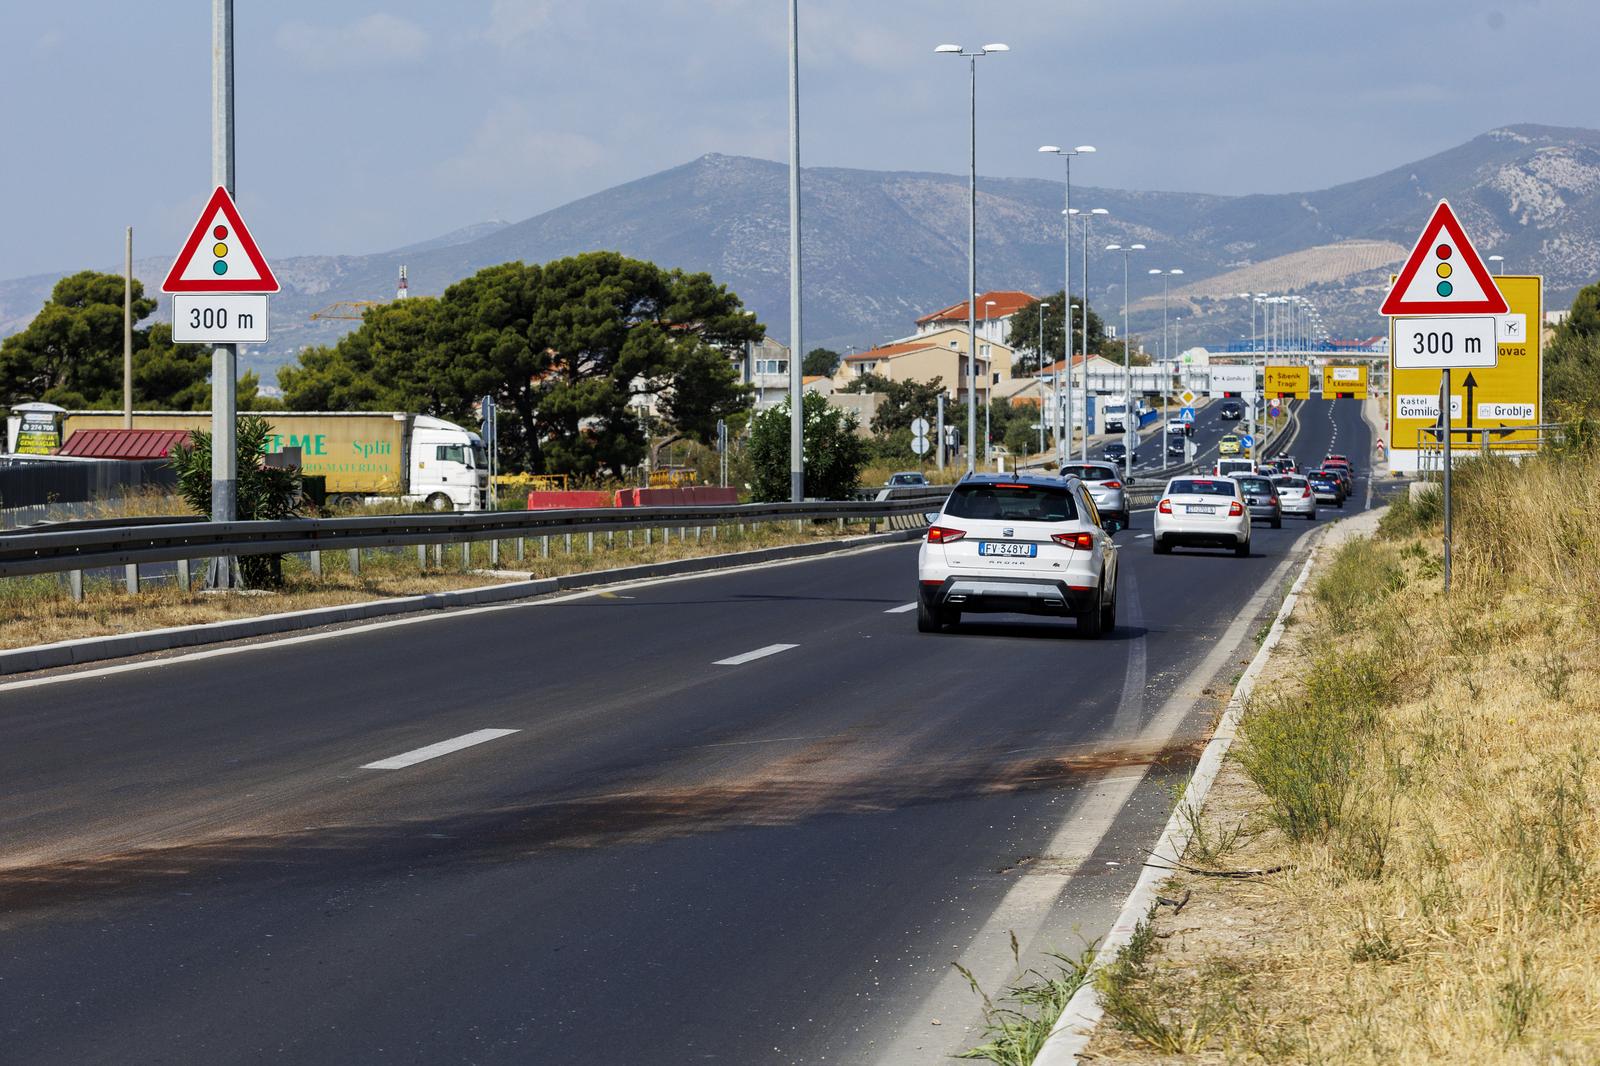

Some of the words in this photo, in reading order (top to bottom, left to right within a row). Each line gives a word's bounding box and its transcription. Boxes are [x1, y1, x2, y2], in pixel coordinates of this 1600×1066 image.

[190, 308, 227, 329] 300
[238, 313, 253, 329] m
[1413, 332, 1453, 354] 300
[1465, 337, 1481, 353] m
[1497, 346, 1526, 356] lovac
[1400, 397, 1427, 405] Kaštel
[1400, 406, 1440, 416] Gomilic
[1494, 406, 1532, 418] Groblje
[352, 440, 391, 458] Split
[985, 544, 997, 553] FV
[1000, 544, 1030, 555] 348YJ
